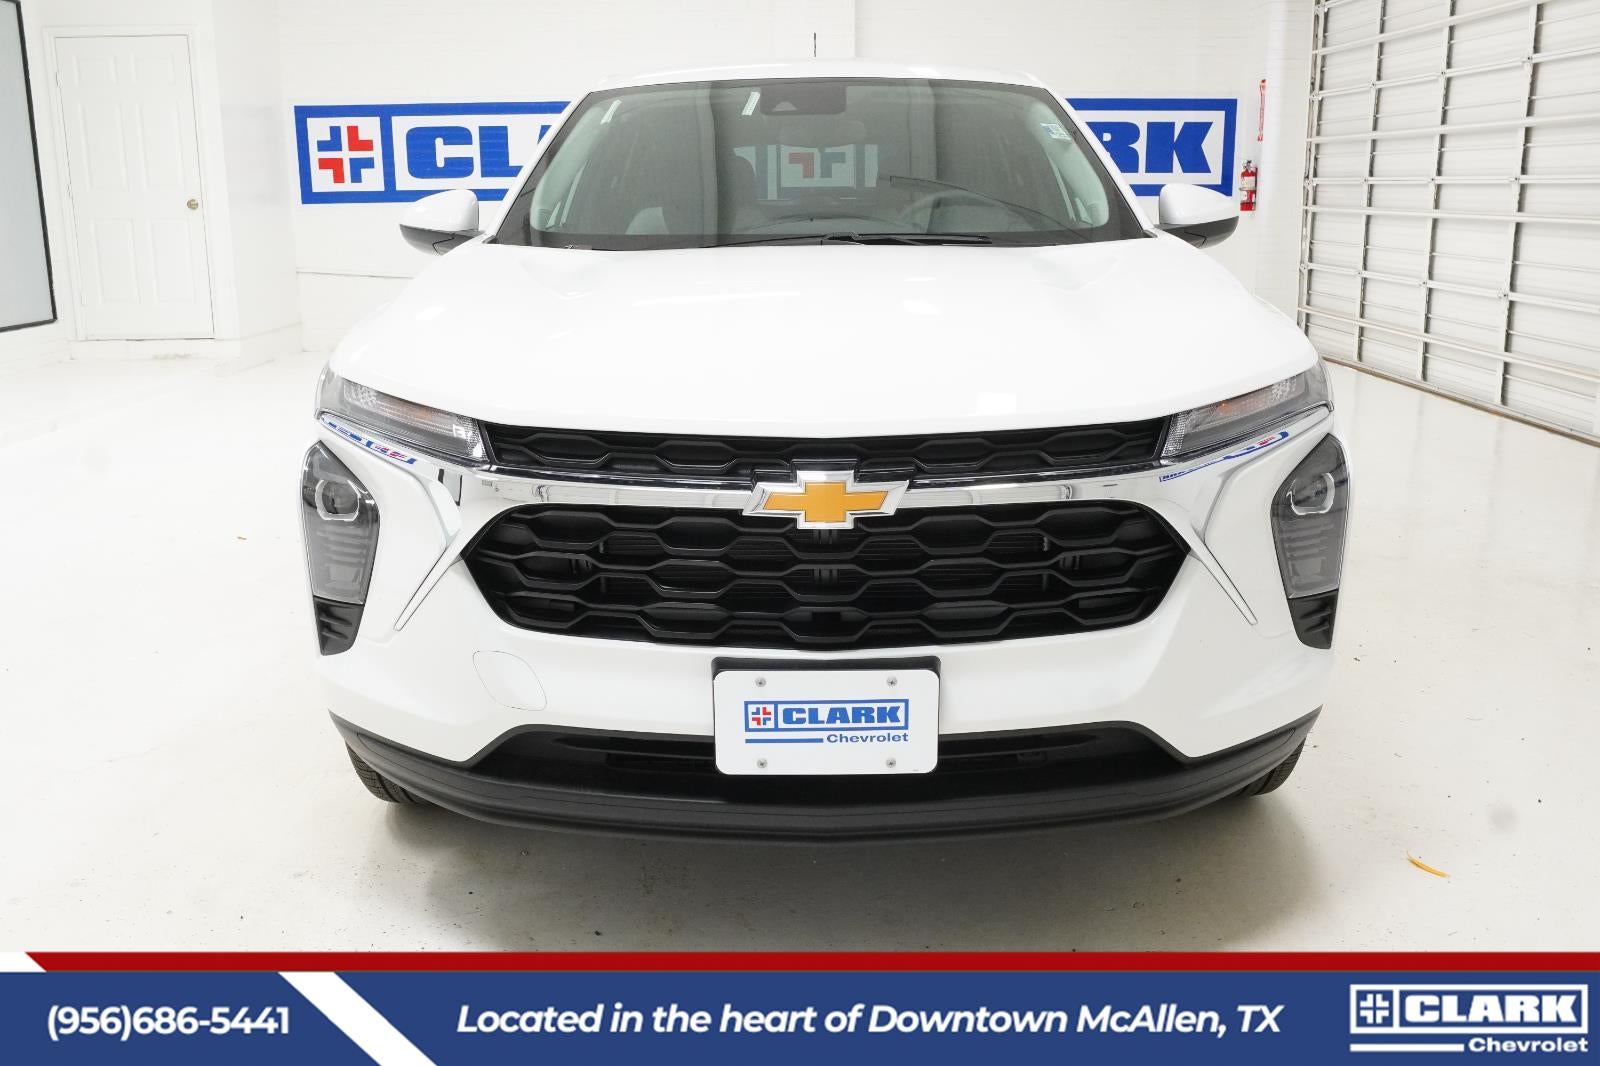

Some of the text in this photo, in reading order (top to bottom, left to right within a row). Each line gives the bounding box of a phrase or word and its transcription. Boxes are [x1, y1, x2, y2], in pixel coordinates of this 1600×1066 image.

[405, 124, 552, 179] CL
[782, 705, 901, 725] CLARK
[826, 732, 909, 744] Chevrolet
